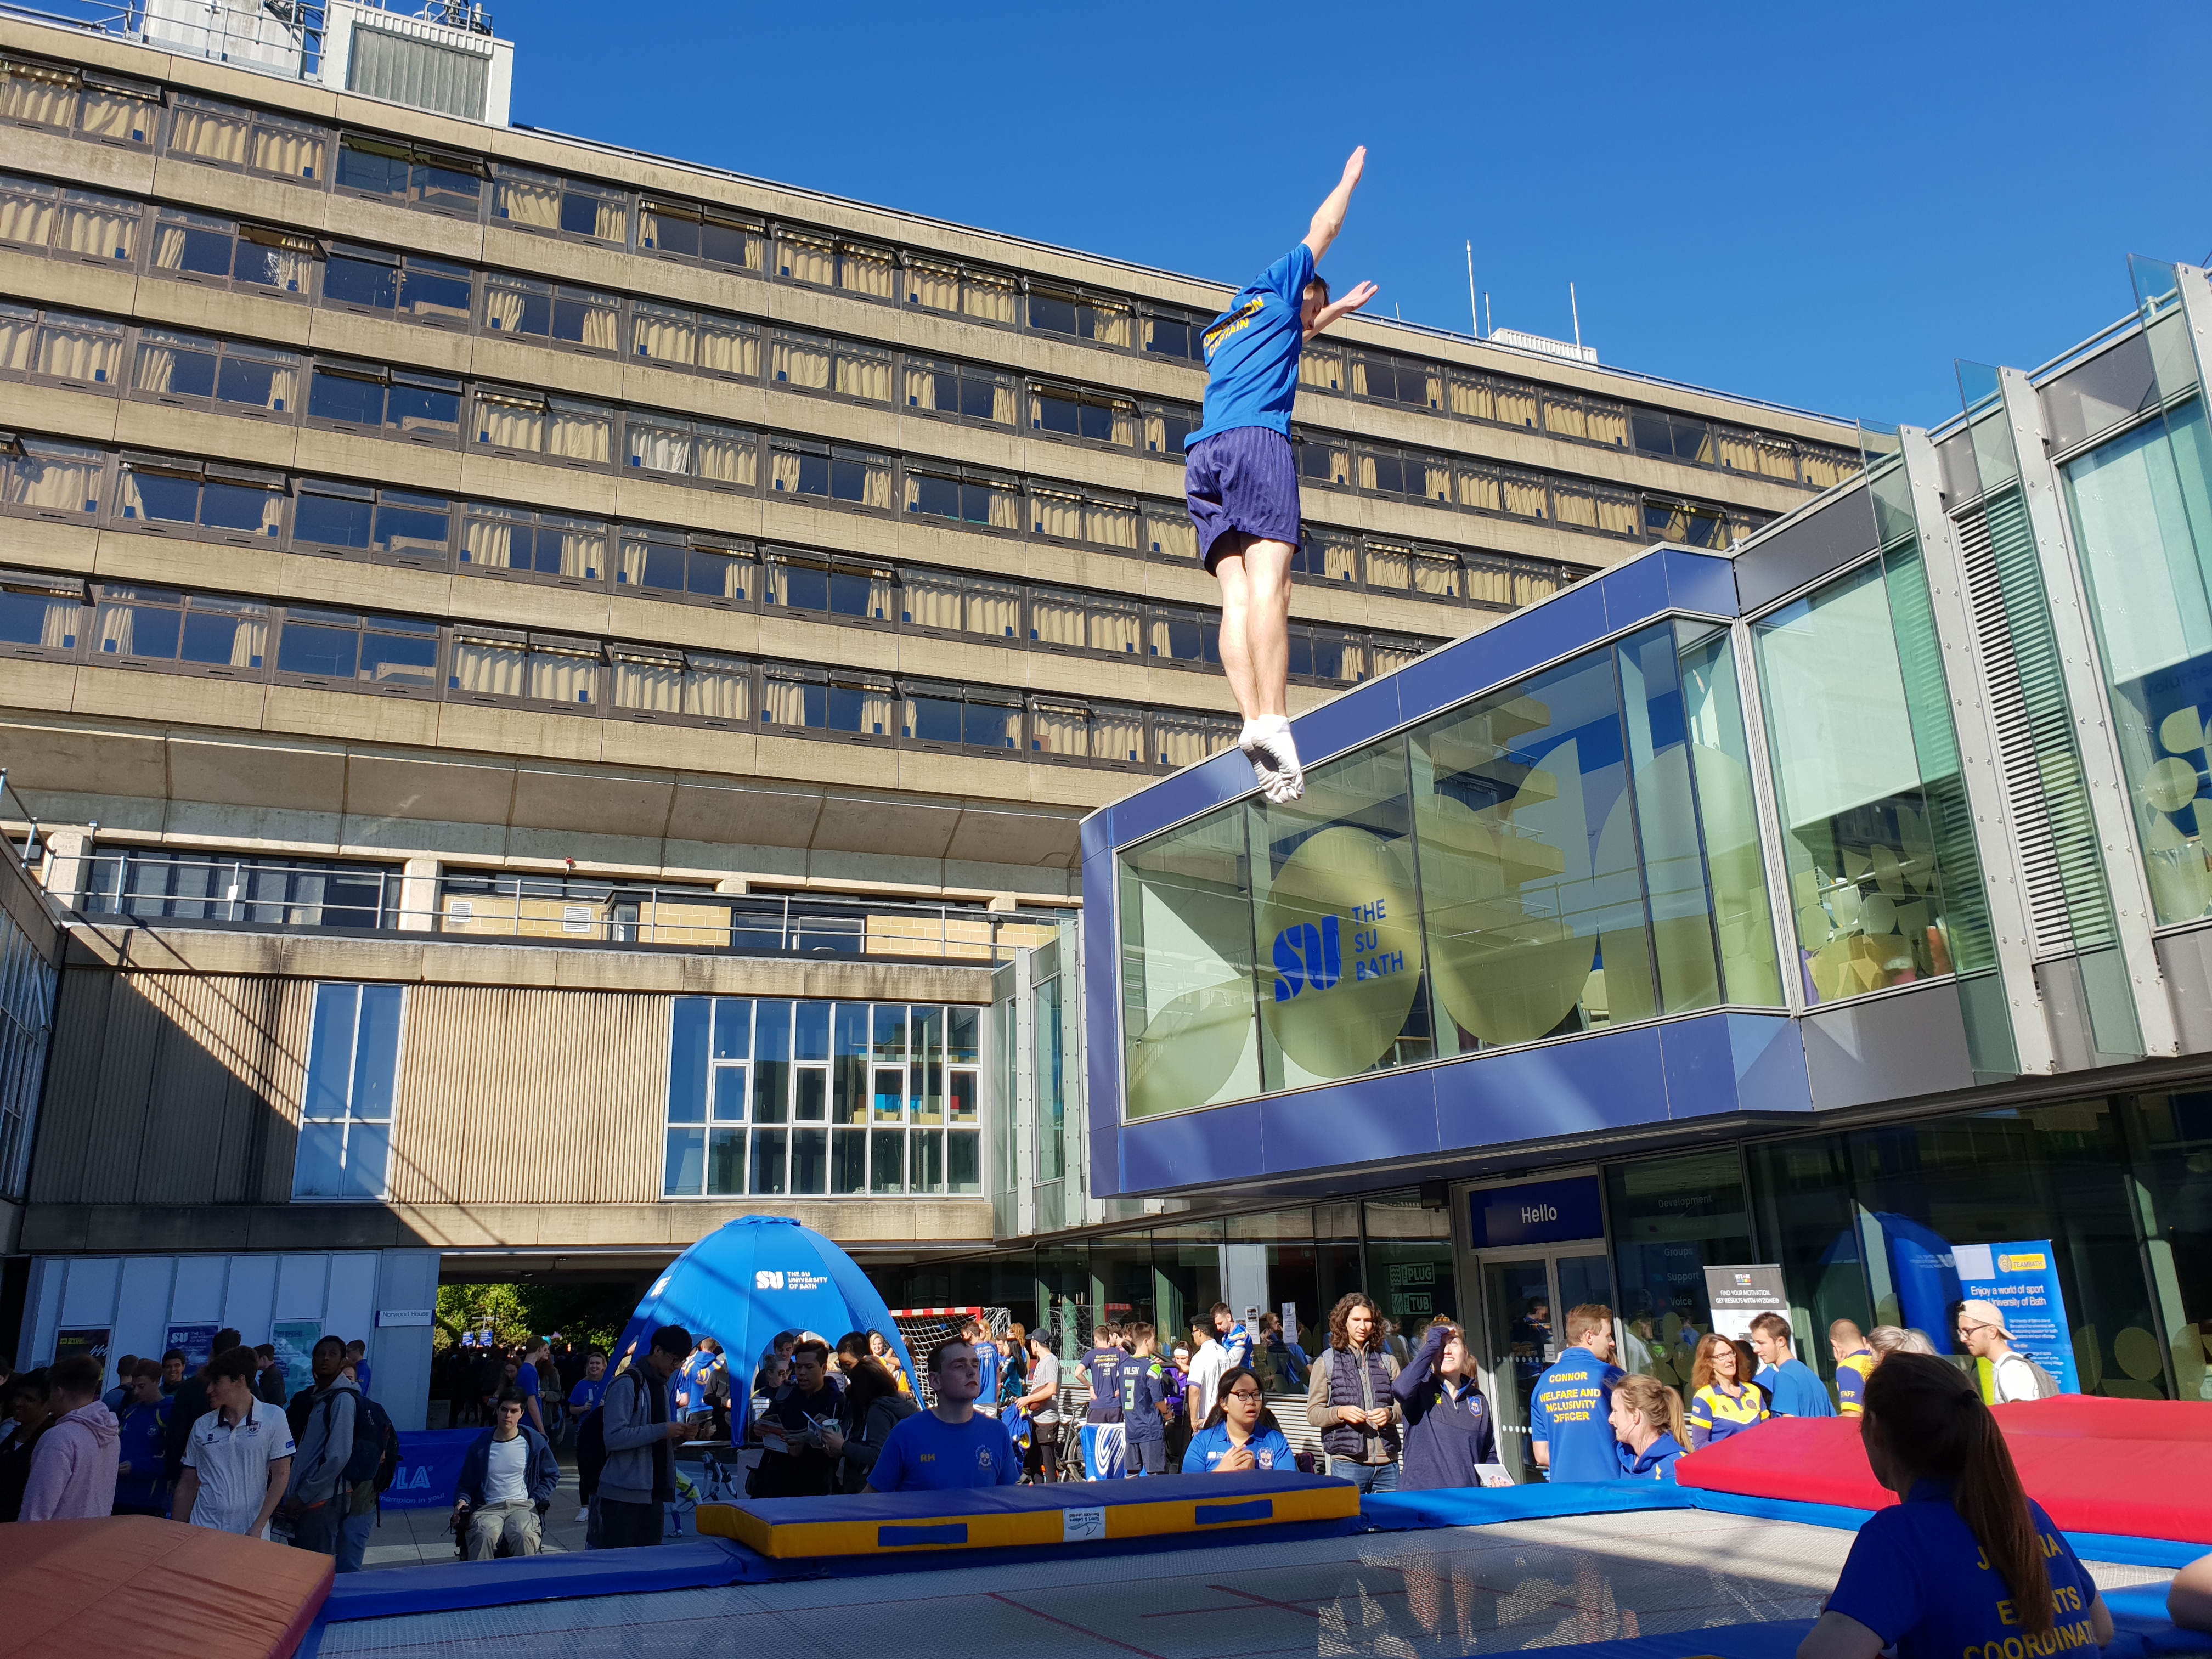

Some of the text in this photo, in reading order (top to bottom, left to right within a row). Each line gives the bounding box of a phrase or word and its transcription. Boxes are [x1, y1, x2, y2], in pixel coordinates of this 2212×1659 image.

[1203, 296, 1264, 349] OMPETITION
[1209, 317, 1249, 357] CAPTAIN
[1351, 898, 1386, 927] THE
[1355, 928, 1378, 953] SU
[1356, 950, 1404, 982] BATH
[1658, 1194, 1712, 1208] Development
[1521, 1203, 1558, 1224] Hello
[1664, 1248, 1694, 1259] Groups
[756, 1270, 785, 1289] SU
[1408, 1266, 1432, 1282] PLUG
[1667, 1271, 1699, 1284] Support
[1971, 1286, 1991, 1297] Enjoy
[1998, 1285, 2017, 1295] world
[2018, 1284, 2025, 1294] of
[2026, 1284, 2045, 1295] sport
[1410, 1296, 1430, 1311] TUB
[1670, 1296, 1693, 1306] Voice
[2021, 1296, 2029, 1306] of
[2030, 1296, 2047, 1306] Bath
[1549, 1372, 1588, 1383] CONNOR
[1125, 1379, 1135, 1410] 3
[1539, 1388, 1601, 1402] WELFARE AND
[1546, 1400, 1596, 1413] NCLUSIVITY
[1554, 1412, 1590, 1423] OFFCER
